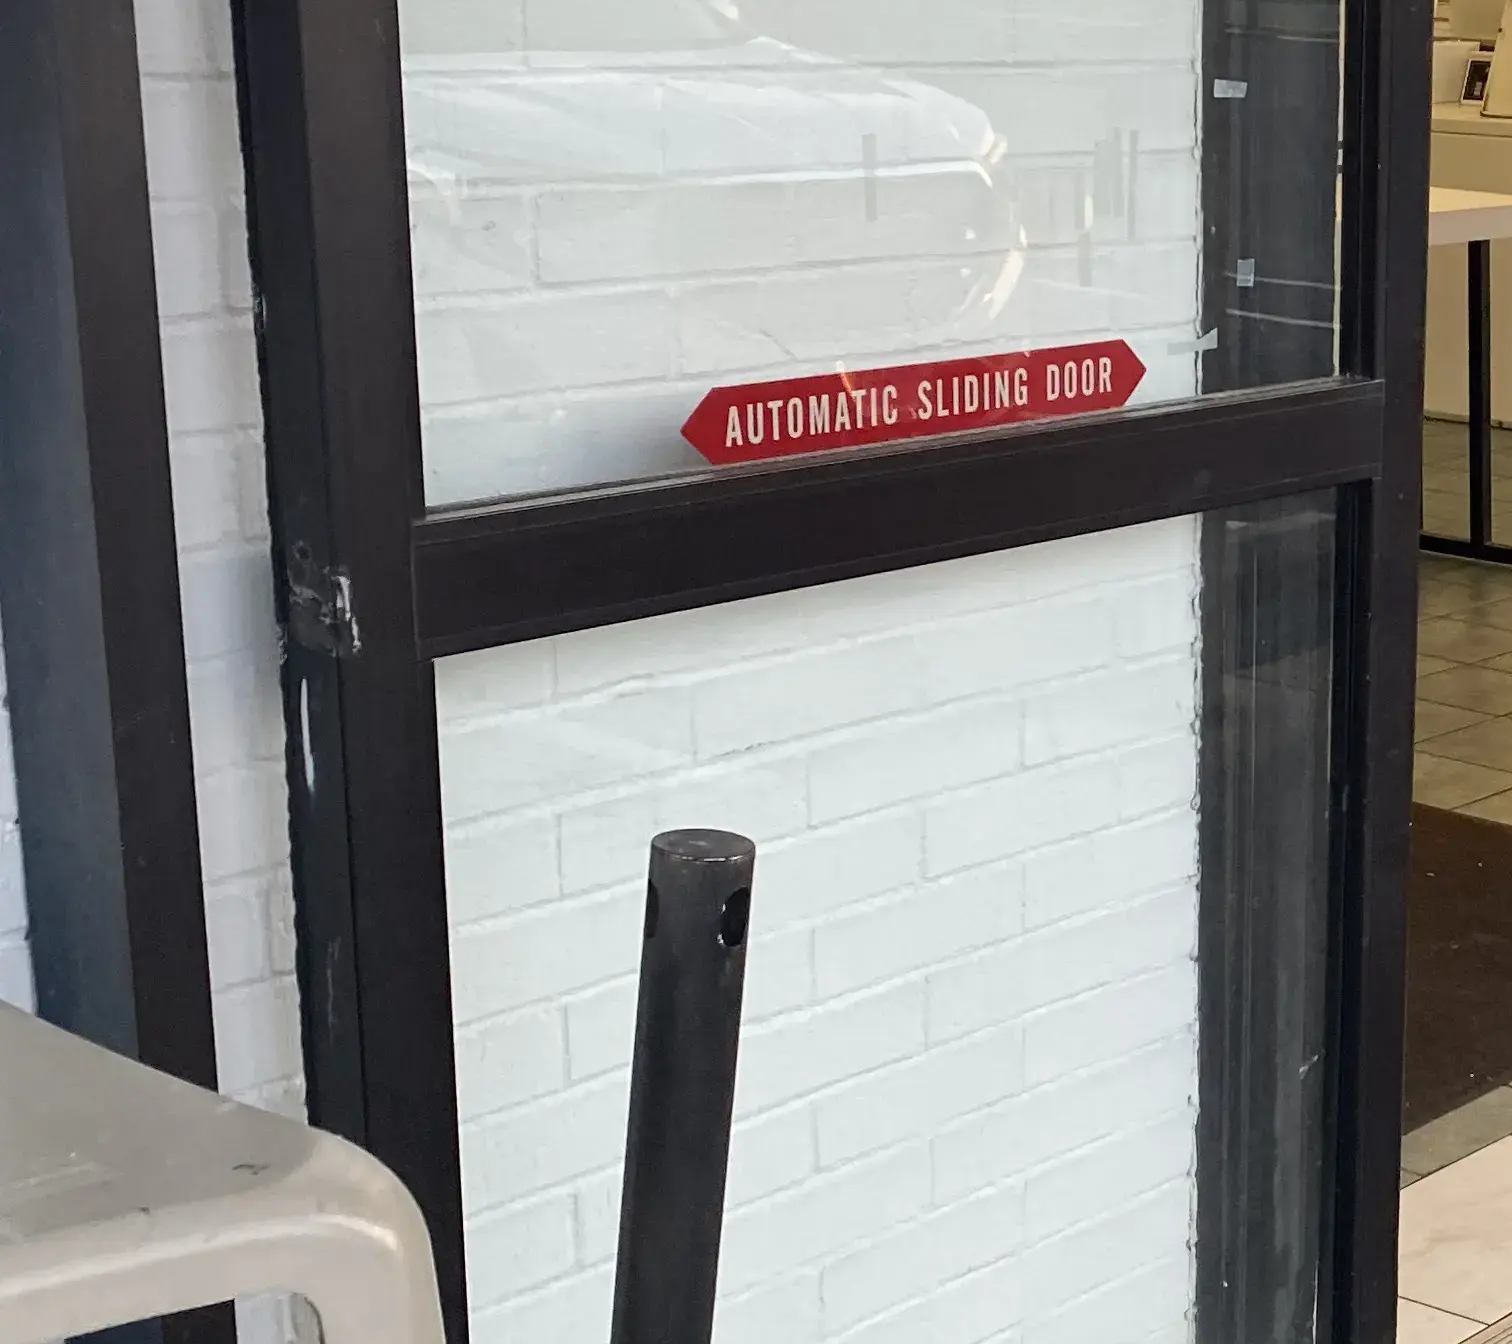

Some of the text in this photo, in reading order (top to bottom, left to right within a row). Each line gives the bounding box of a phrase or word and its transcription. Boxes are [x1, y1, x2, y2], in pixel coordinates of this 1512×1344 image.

[725, 357, 1112, 447] AUTOMATIC SLIDING DOOR
